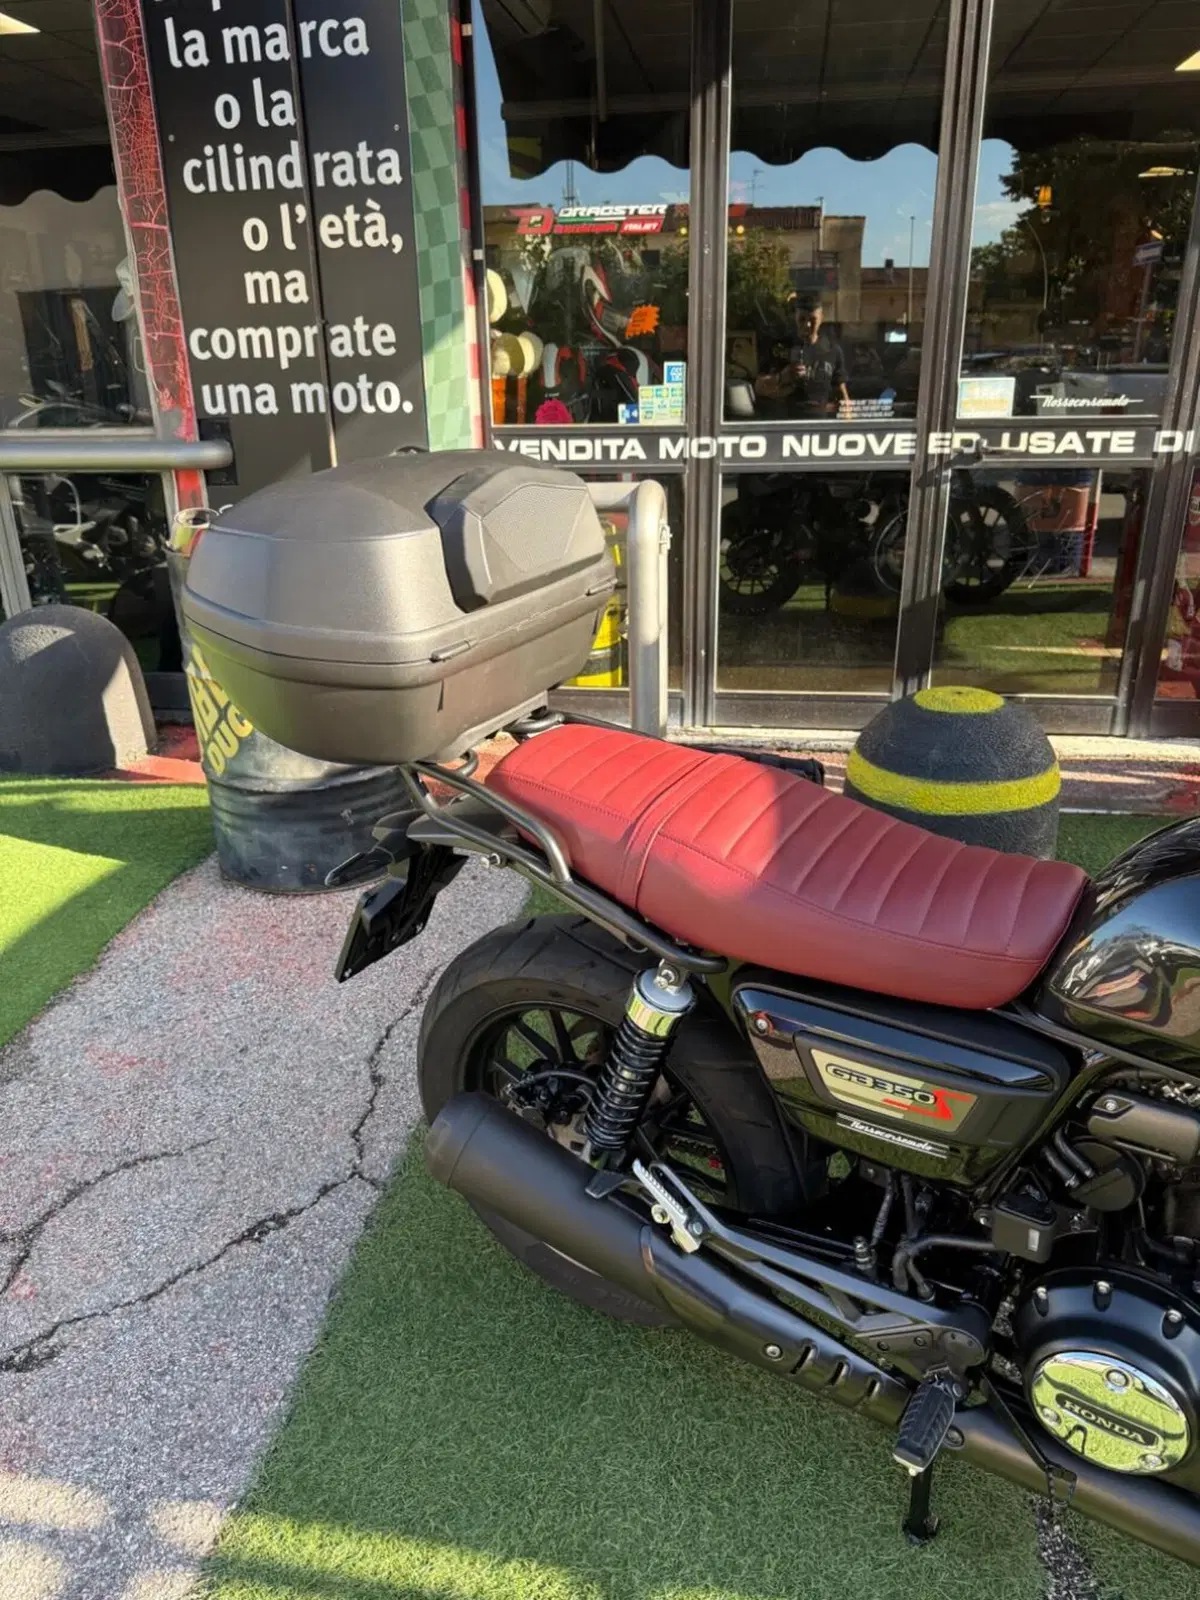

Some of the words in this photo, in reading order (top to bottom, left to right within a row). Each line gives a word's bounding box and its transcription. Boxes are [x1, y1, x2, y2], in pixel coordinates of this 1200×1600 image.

[164, 17, 209, 69] la
[221, 16, 369, 64] marca
[214, 93, 241, 129] o
[252, 78, 297, 127] la
[183, 140, 403, 194] cilindrata
[558, 203, 668, 218] DRAGSTER
[242, 217, 269, 252] o
[244, 269, 309, 304] ma
[189, 316, 397, 370] comprate
[202, 381, 279, 415] una
[290, 374, 414, 414] moto.
[493, 437, 647, 462] VENDITA
[658, 435, 767, 460] MOTO
[782, 433, 917, 458] NUOVE
[927, 432, 981, 454] ED
[1000, 431, 1135, 454] USATE
[1152, 430, 1194, 454] DI
[825, 1063, 937, 1106] GB350
[1063, 1400, 1146, 1444] HONDA
